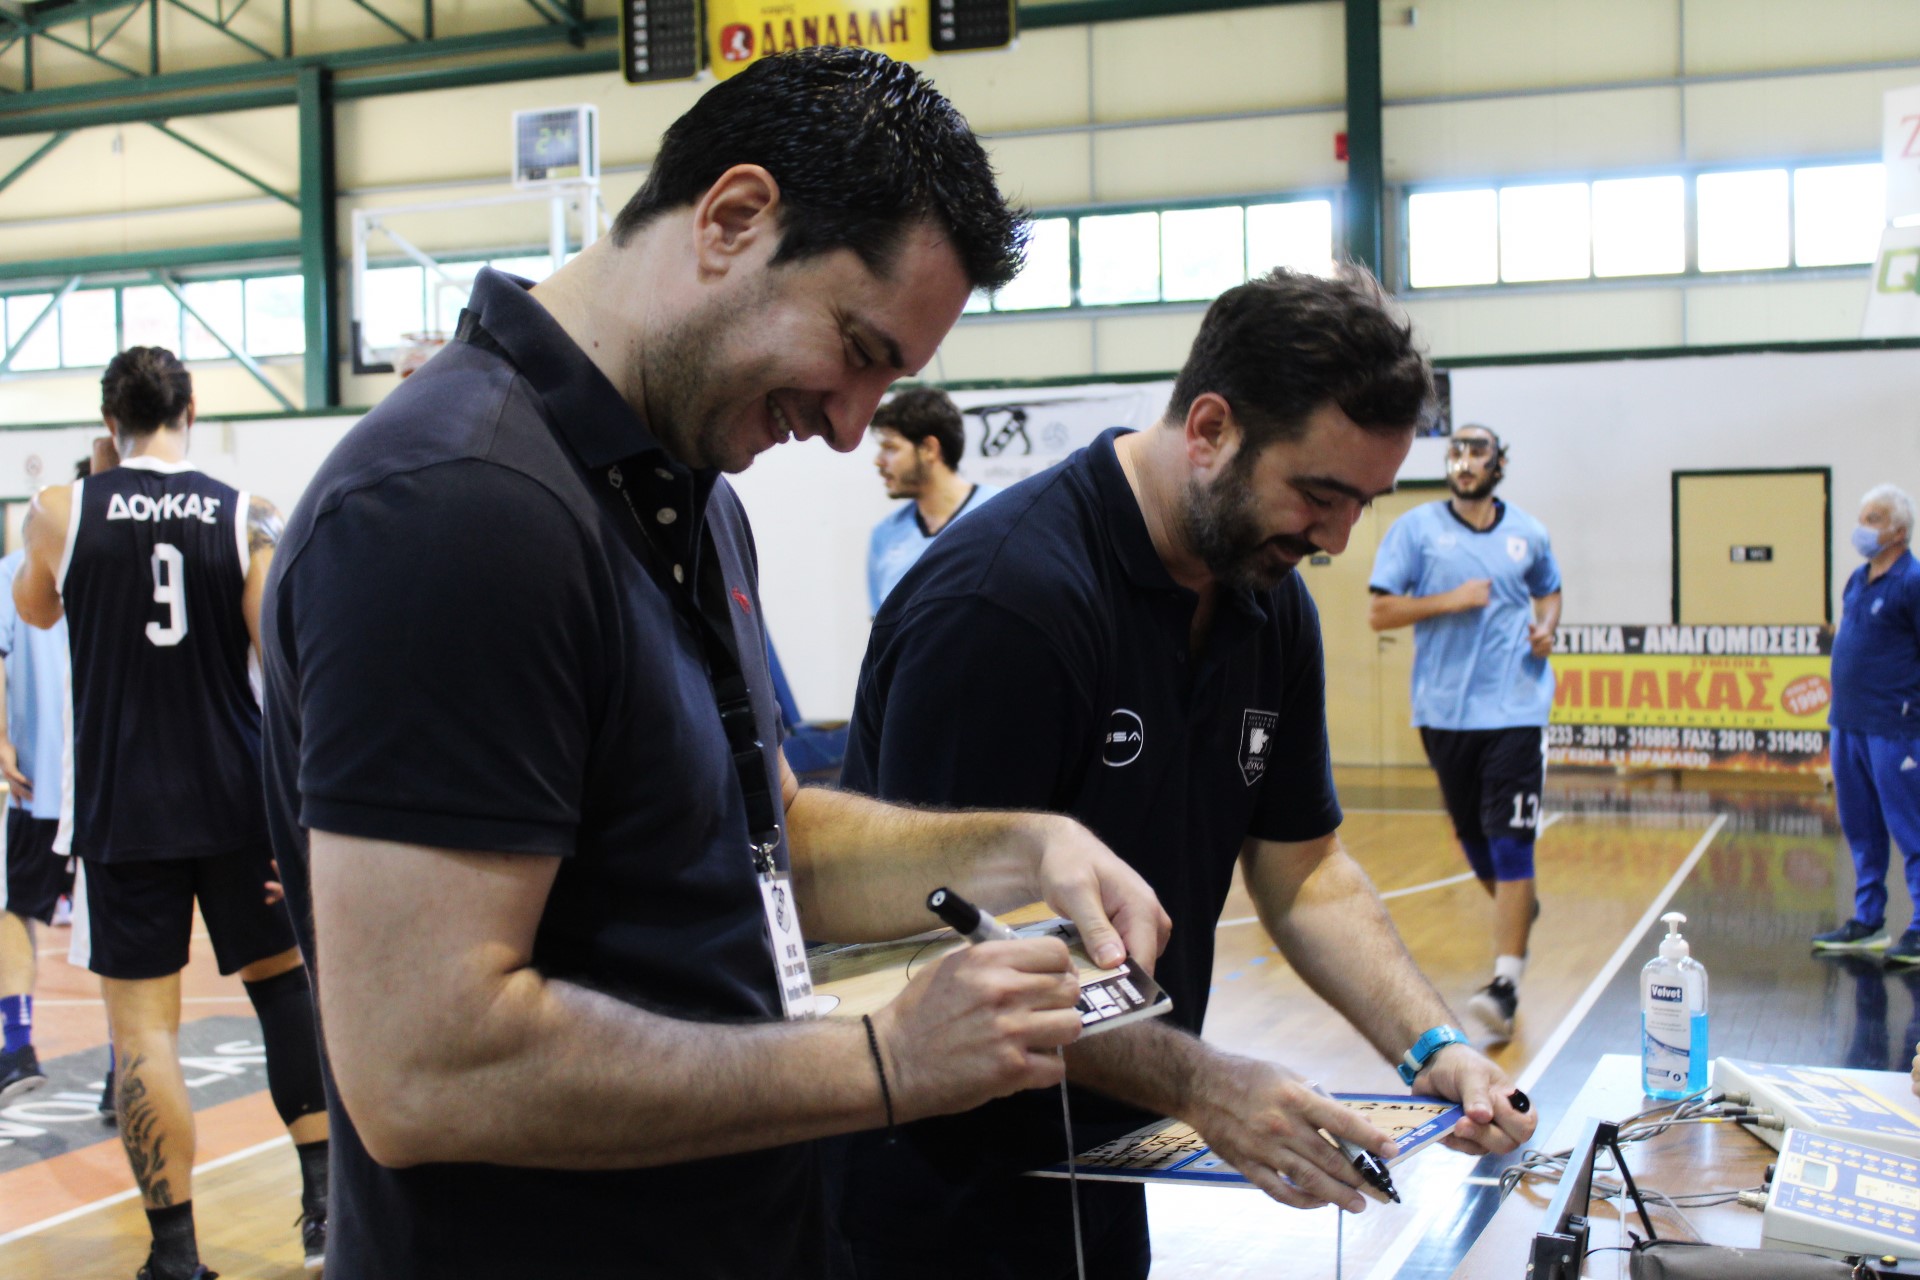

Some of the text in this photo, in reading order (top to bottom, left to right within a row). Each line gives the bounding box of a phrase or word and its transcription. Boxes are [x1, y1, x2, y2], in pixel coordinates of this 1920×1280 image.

[106, 492, 221, 525] ΔΟΥΚΑΣ
[145, 542, 189, 647] 9
[1552, 626, 1625, 654] ΣΤΙΚΑ
[1643, 626, 1821, 655] ΑΝΑΓΟΜΩΣΕΙΣ
[1554, 669, 1775, 713] ΜΠΑΚΑΣ
[1548, 725, 1574, 746] 233
[1509, 792, 1539, 829] 13
[1651, 985, 1682, 999] Velvet
